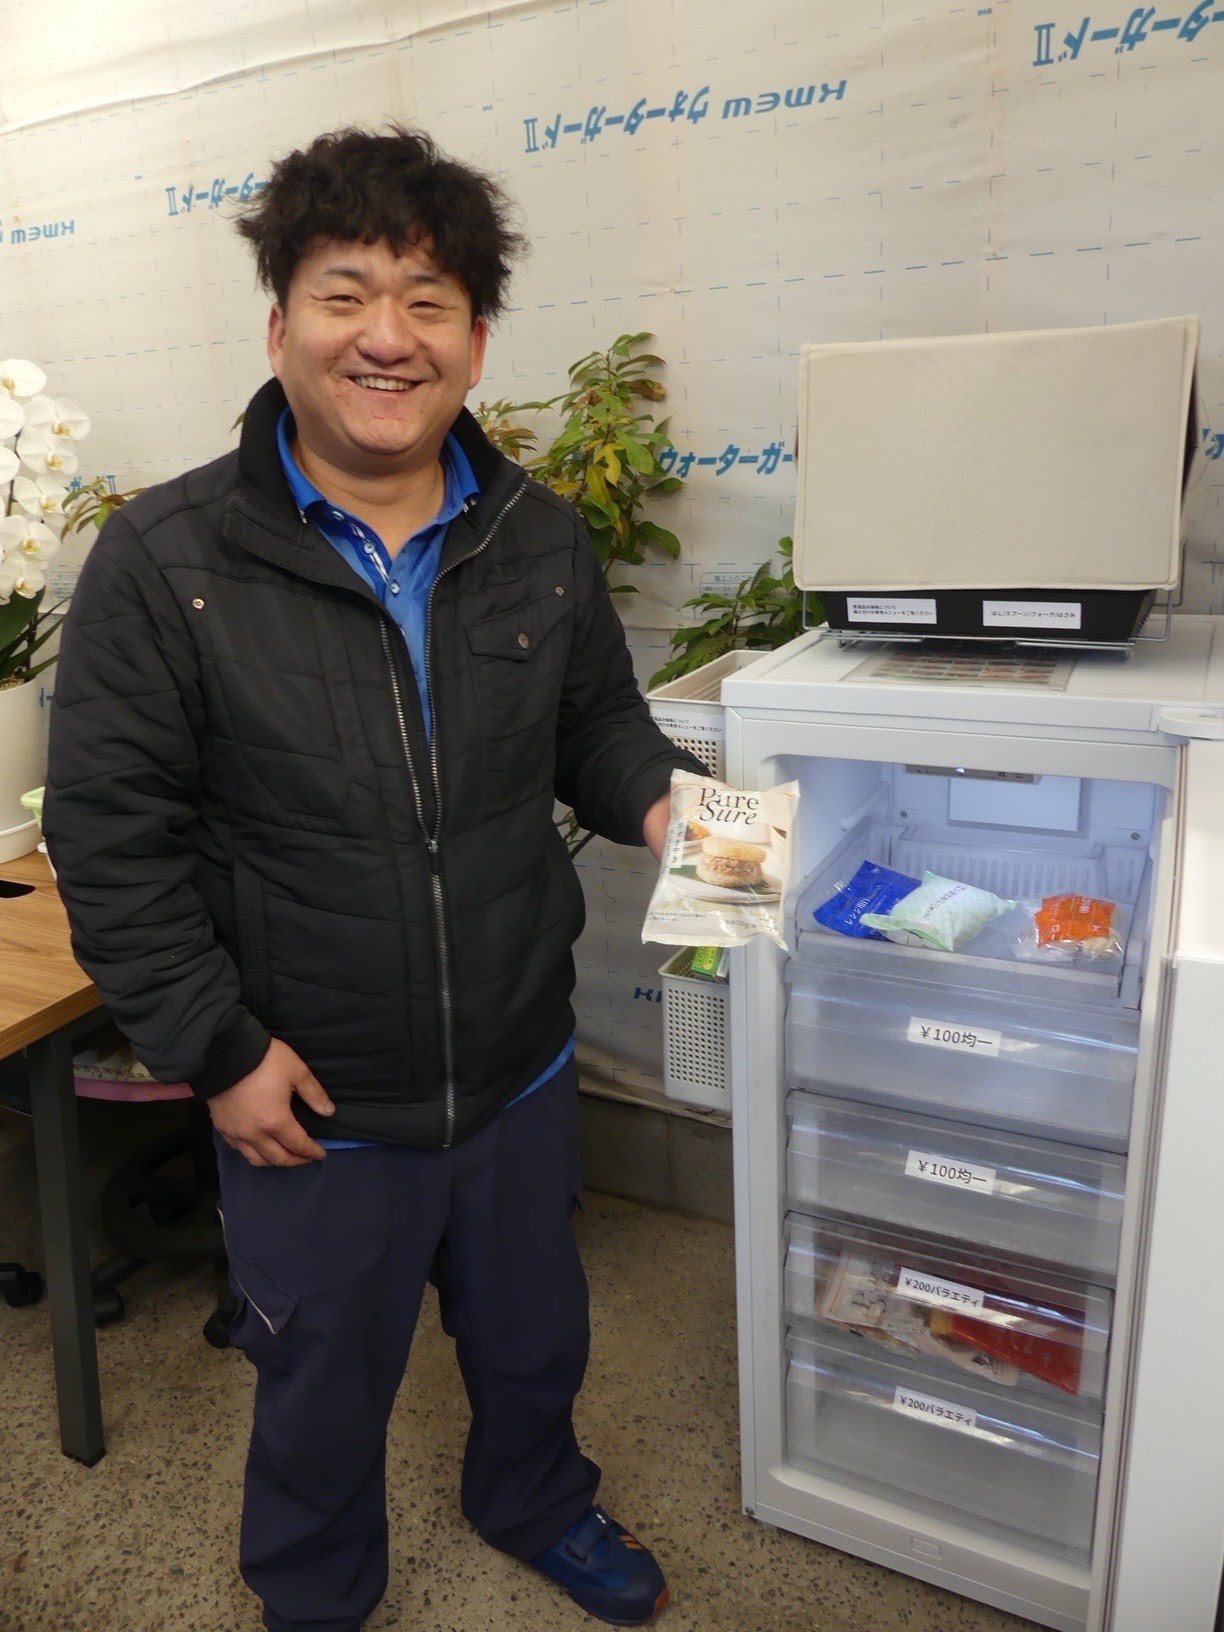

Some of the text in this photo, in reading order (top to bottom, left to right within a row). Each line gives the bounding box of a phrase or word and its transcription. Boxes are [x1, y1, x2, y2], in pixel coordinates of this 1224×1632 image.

[722, 80, 848, 120] KMEW
[11, 219, 76, 245] KMEW
[698, 787, 760, 811] Pure
[700, 799, 757, 825] Sure
[920, 1023, 993, 1049] ¥100均一
[917, 1158, 988, 1185] ¥100均一
[904, 1276, 981, 1308] ¥200バラエティ
[899, 1394, 974, 1428] ¥200バラエティ
